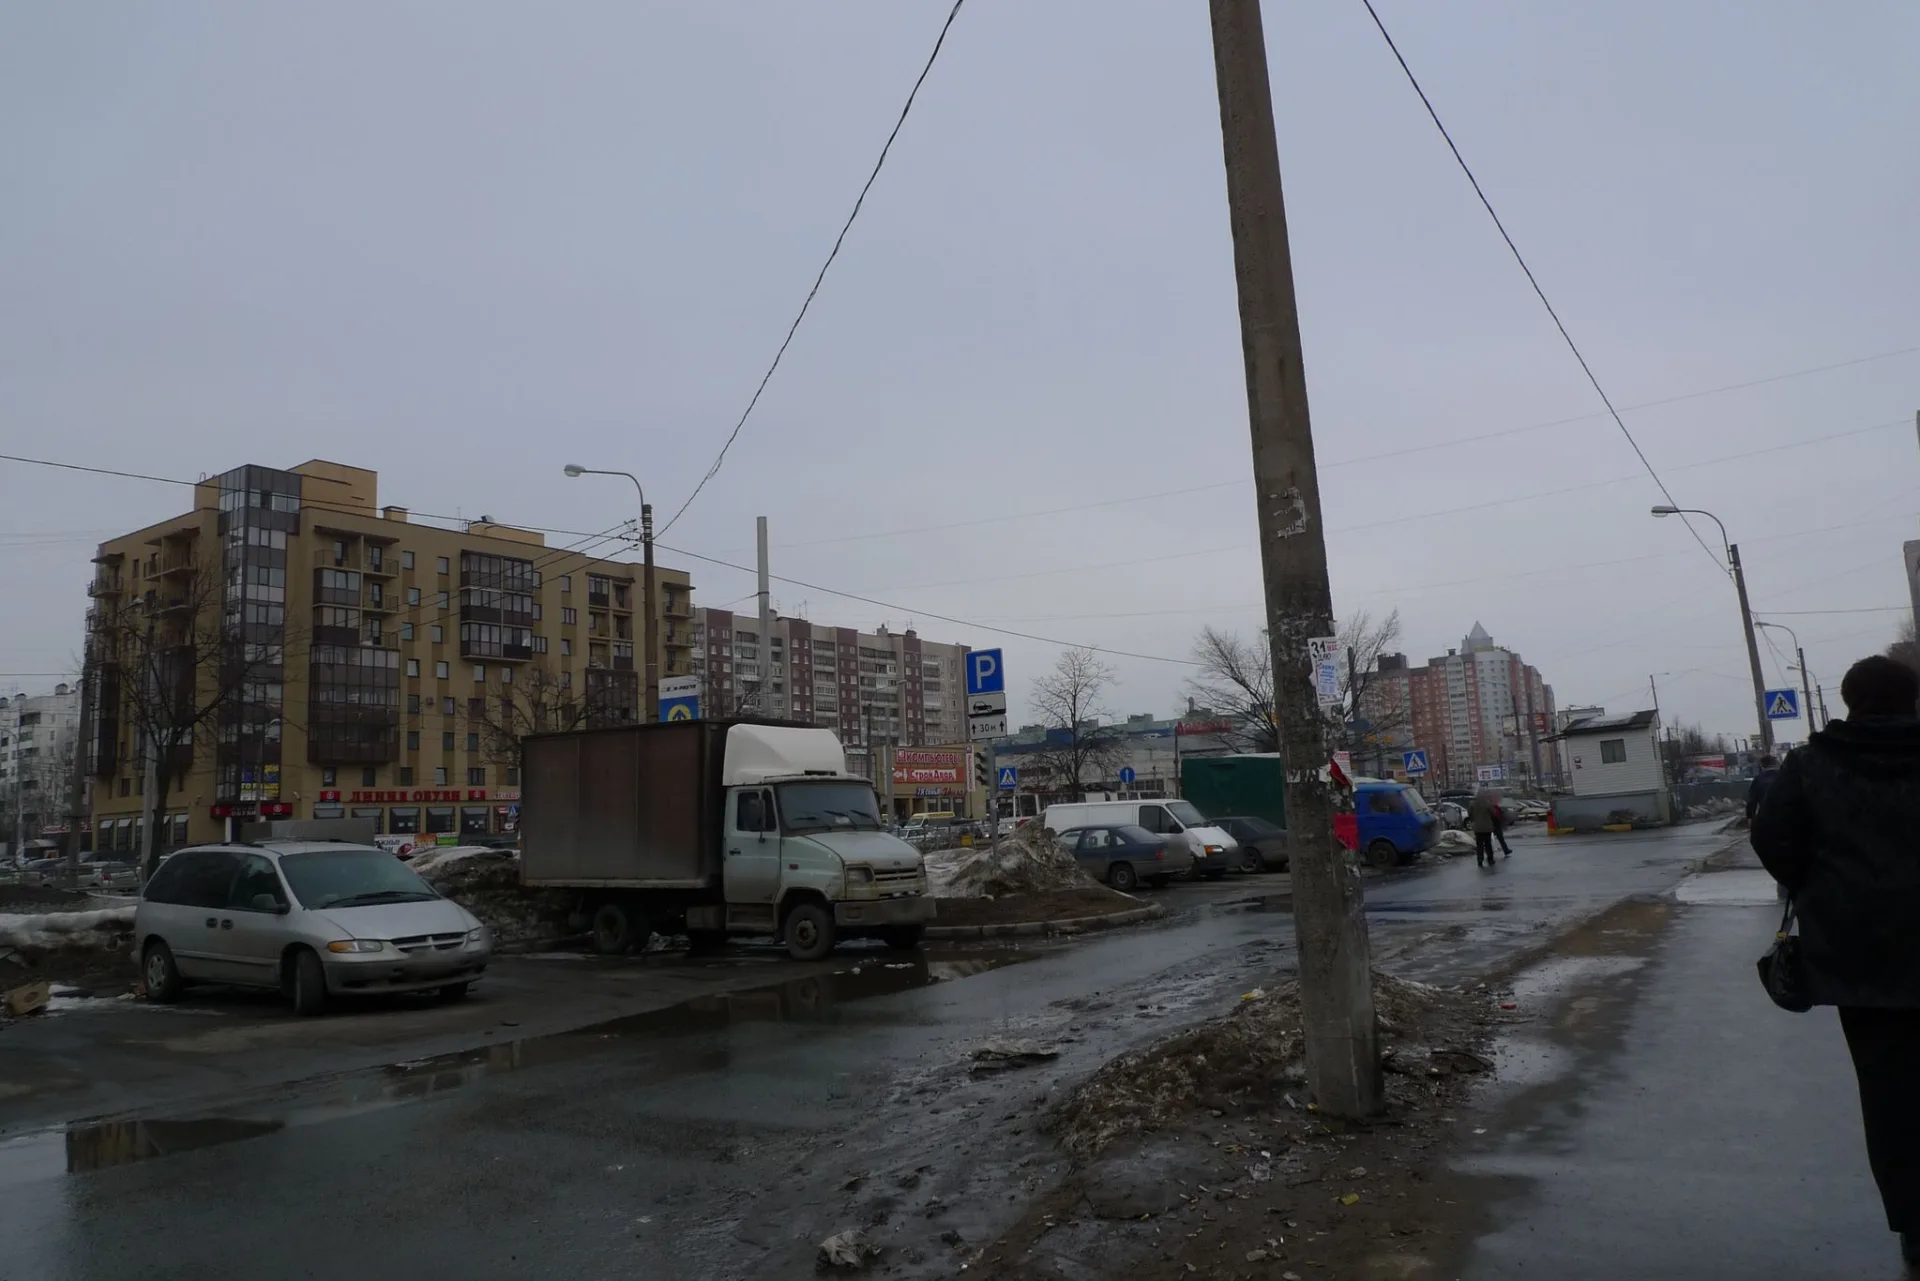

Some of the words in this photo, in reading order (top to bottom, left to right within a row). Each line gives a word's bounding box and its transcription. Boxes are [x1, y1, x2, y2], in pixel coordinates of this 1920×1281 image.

[976, 655, 996, 690] P
[980, 723, 990, 733] 30
[906, 752, 961, 764] КОМПЬЮТЕРЫ
[413, 790, 460, 801] ОБУВИ
